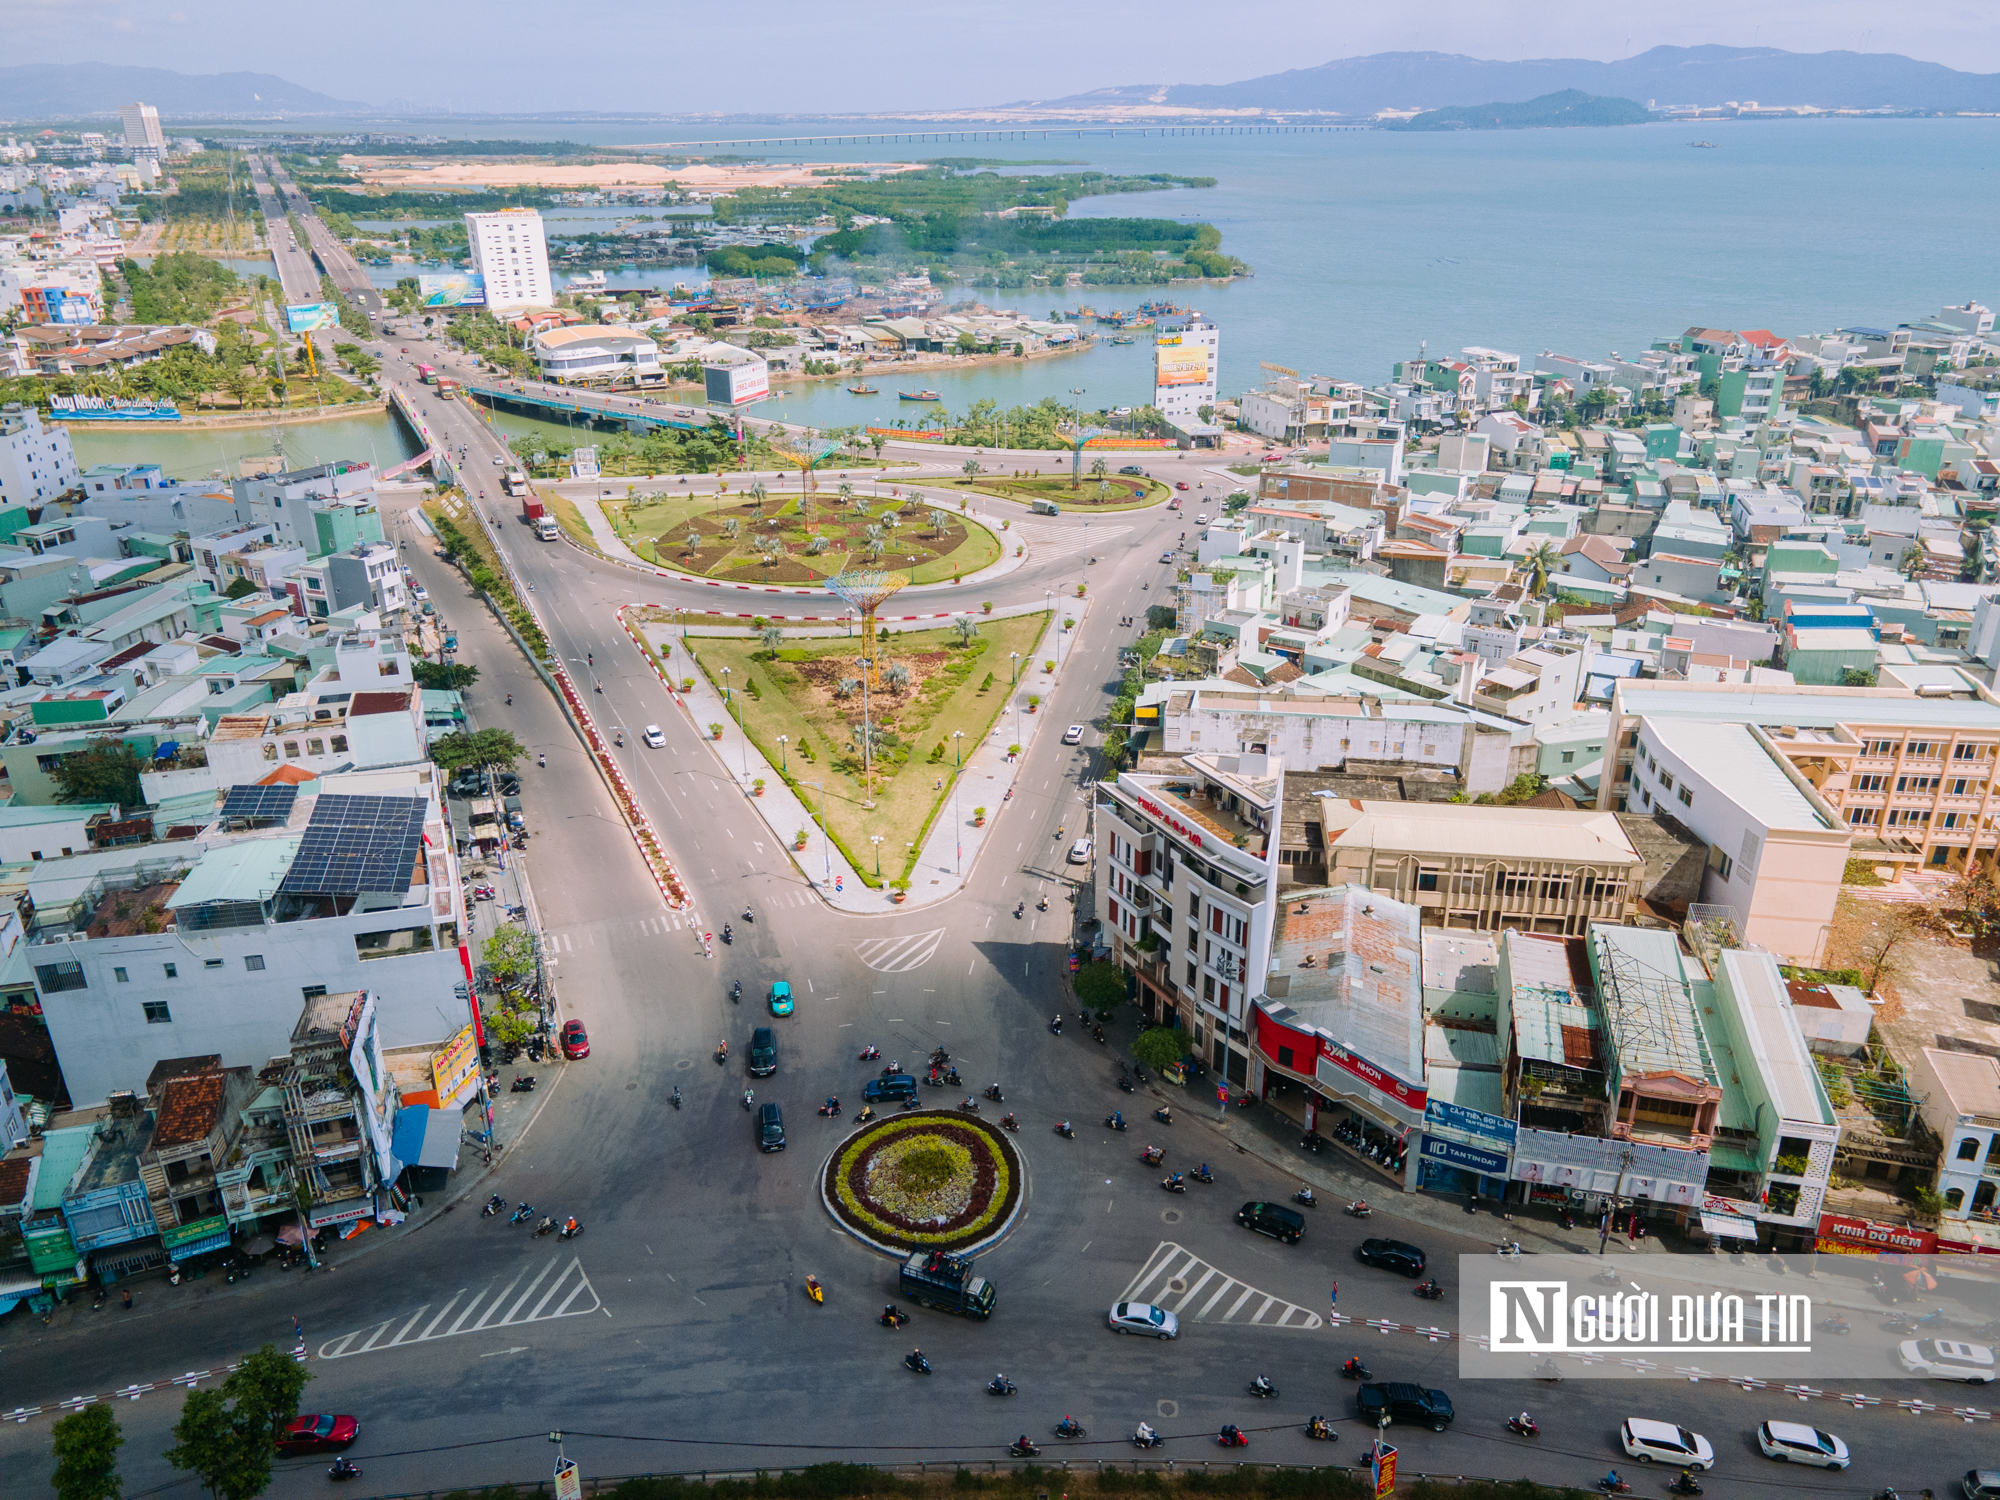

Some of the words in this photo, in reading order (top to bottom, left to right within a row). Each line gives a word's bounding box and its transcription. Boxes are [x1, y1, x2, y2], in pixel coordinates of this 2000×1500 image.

[50, 394, 76, 412] Quy
[1324, 1041, 1350, 1062] SYM
[436, 1055, 448, 1071] ANH
[1483, 1116, 1497, 1126] GỌI
[1497, 1119, 1514, 1130] LỀN
[1833, 1223, 1866, 1238] KINH
